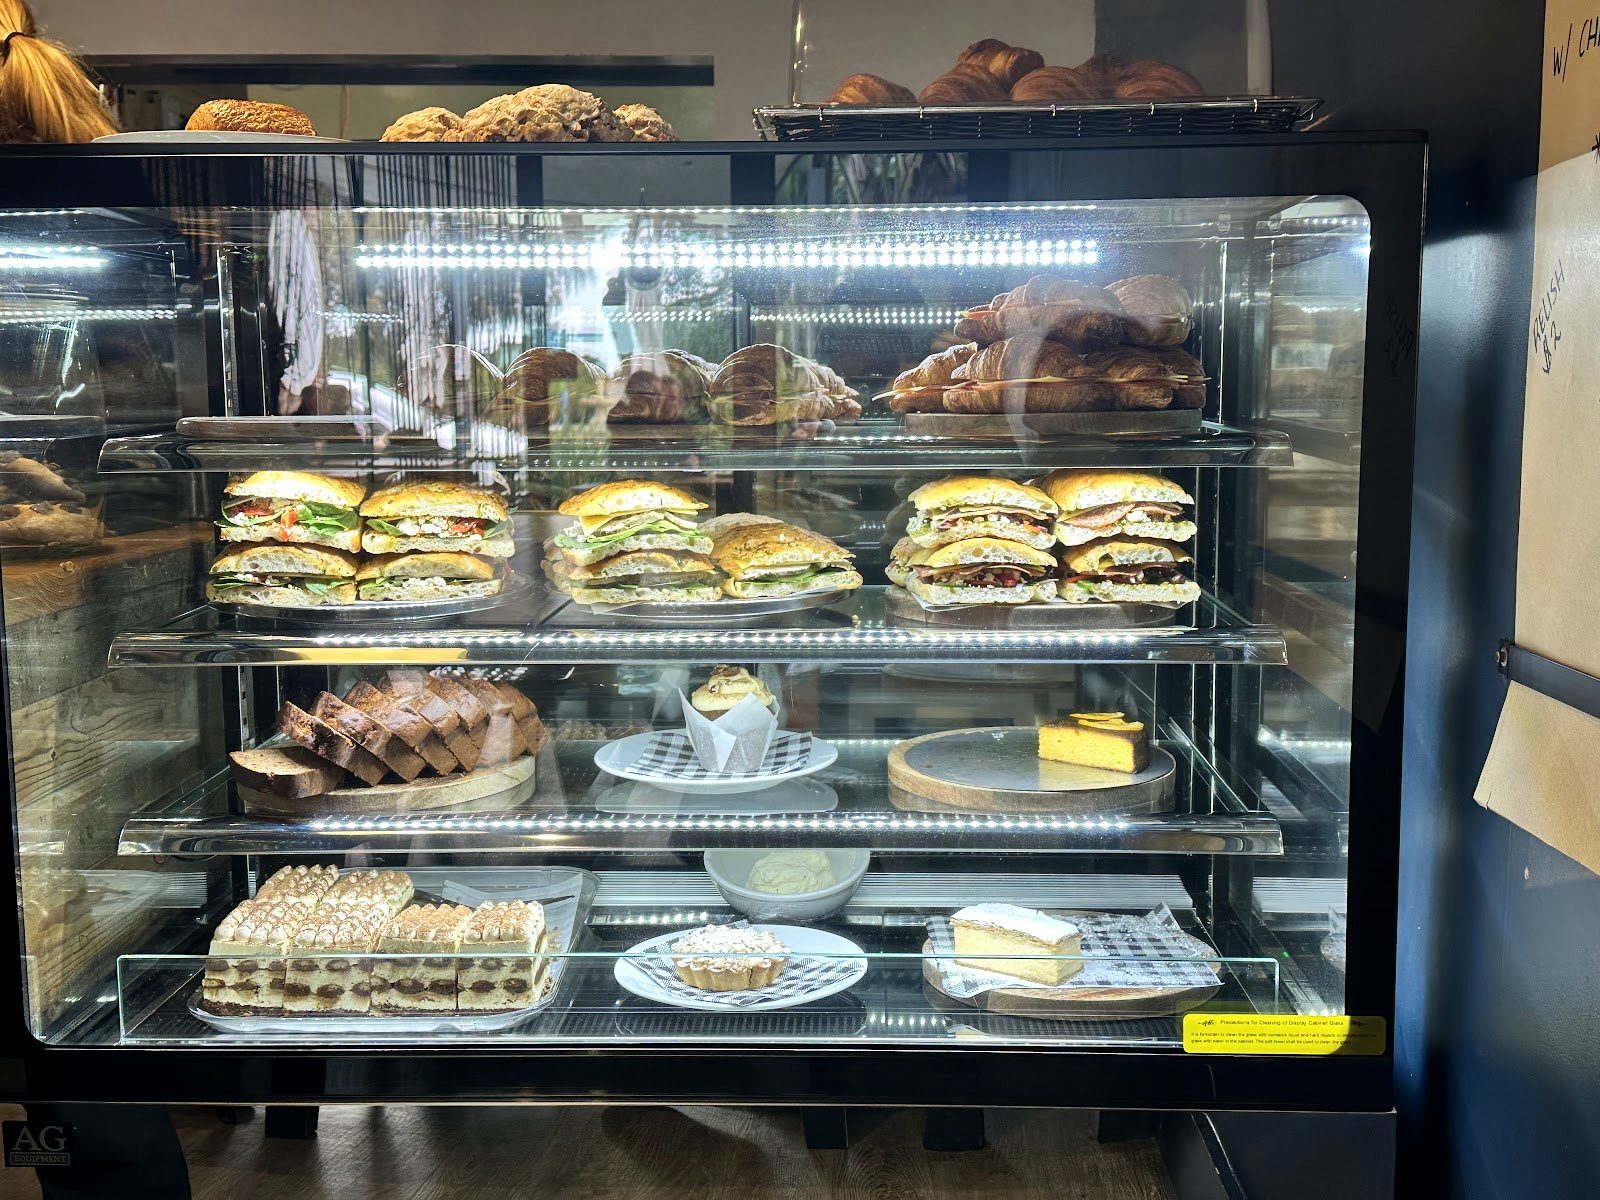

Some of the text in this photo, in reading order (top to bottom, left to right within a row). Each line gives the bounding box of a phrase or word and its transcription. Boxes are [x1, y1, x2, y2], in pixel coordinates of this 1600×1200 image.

[1579, 16, 1600, 57] CH
[1533, 258, 1565, 354] RELISH
[1542, 320, 1562, 375] $2
[12, 1126, 66, 1151] AG
[14, 1154, 66, 1164] EQUIPMENT
